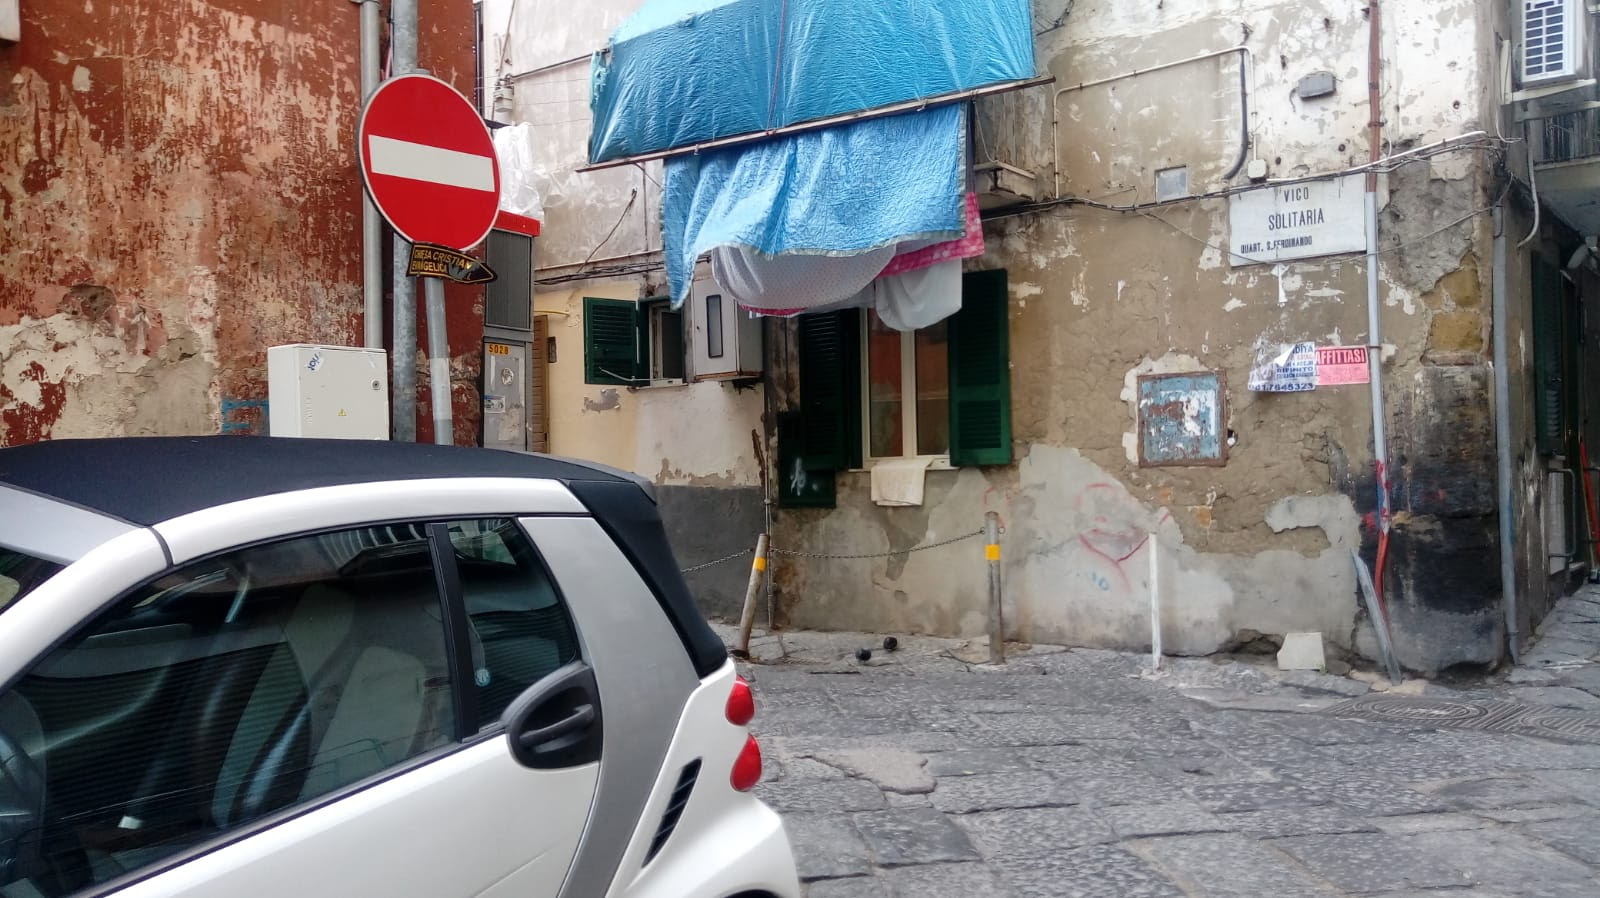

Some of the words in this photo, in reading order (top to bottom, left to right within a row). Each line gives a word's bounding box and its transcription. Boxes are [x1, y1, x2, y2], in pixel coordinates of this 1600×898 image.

[1284, 187, 1309, 203] VICO
[1268, 207, 1325, 231] SOLITARIA
[489, 344, 508, 354] 5028
[1316, 349, 1365, 364] AFFITTASI
